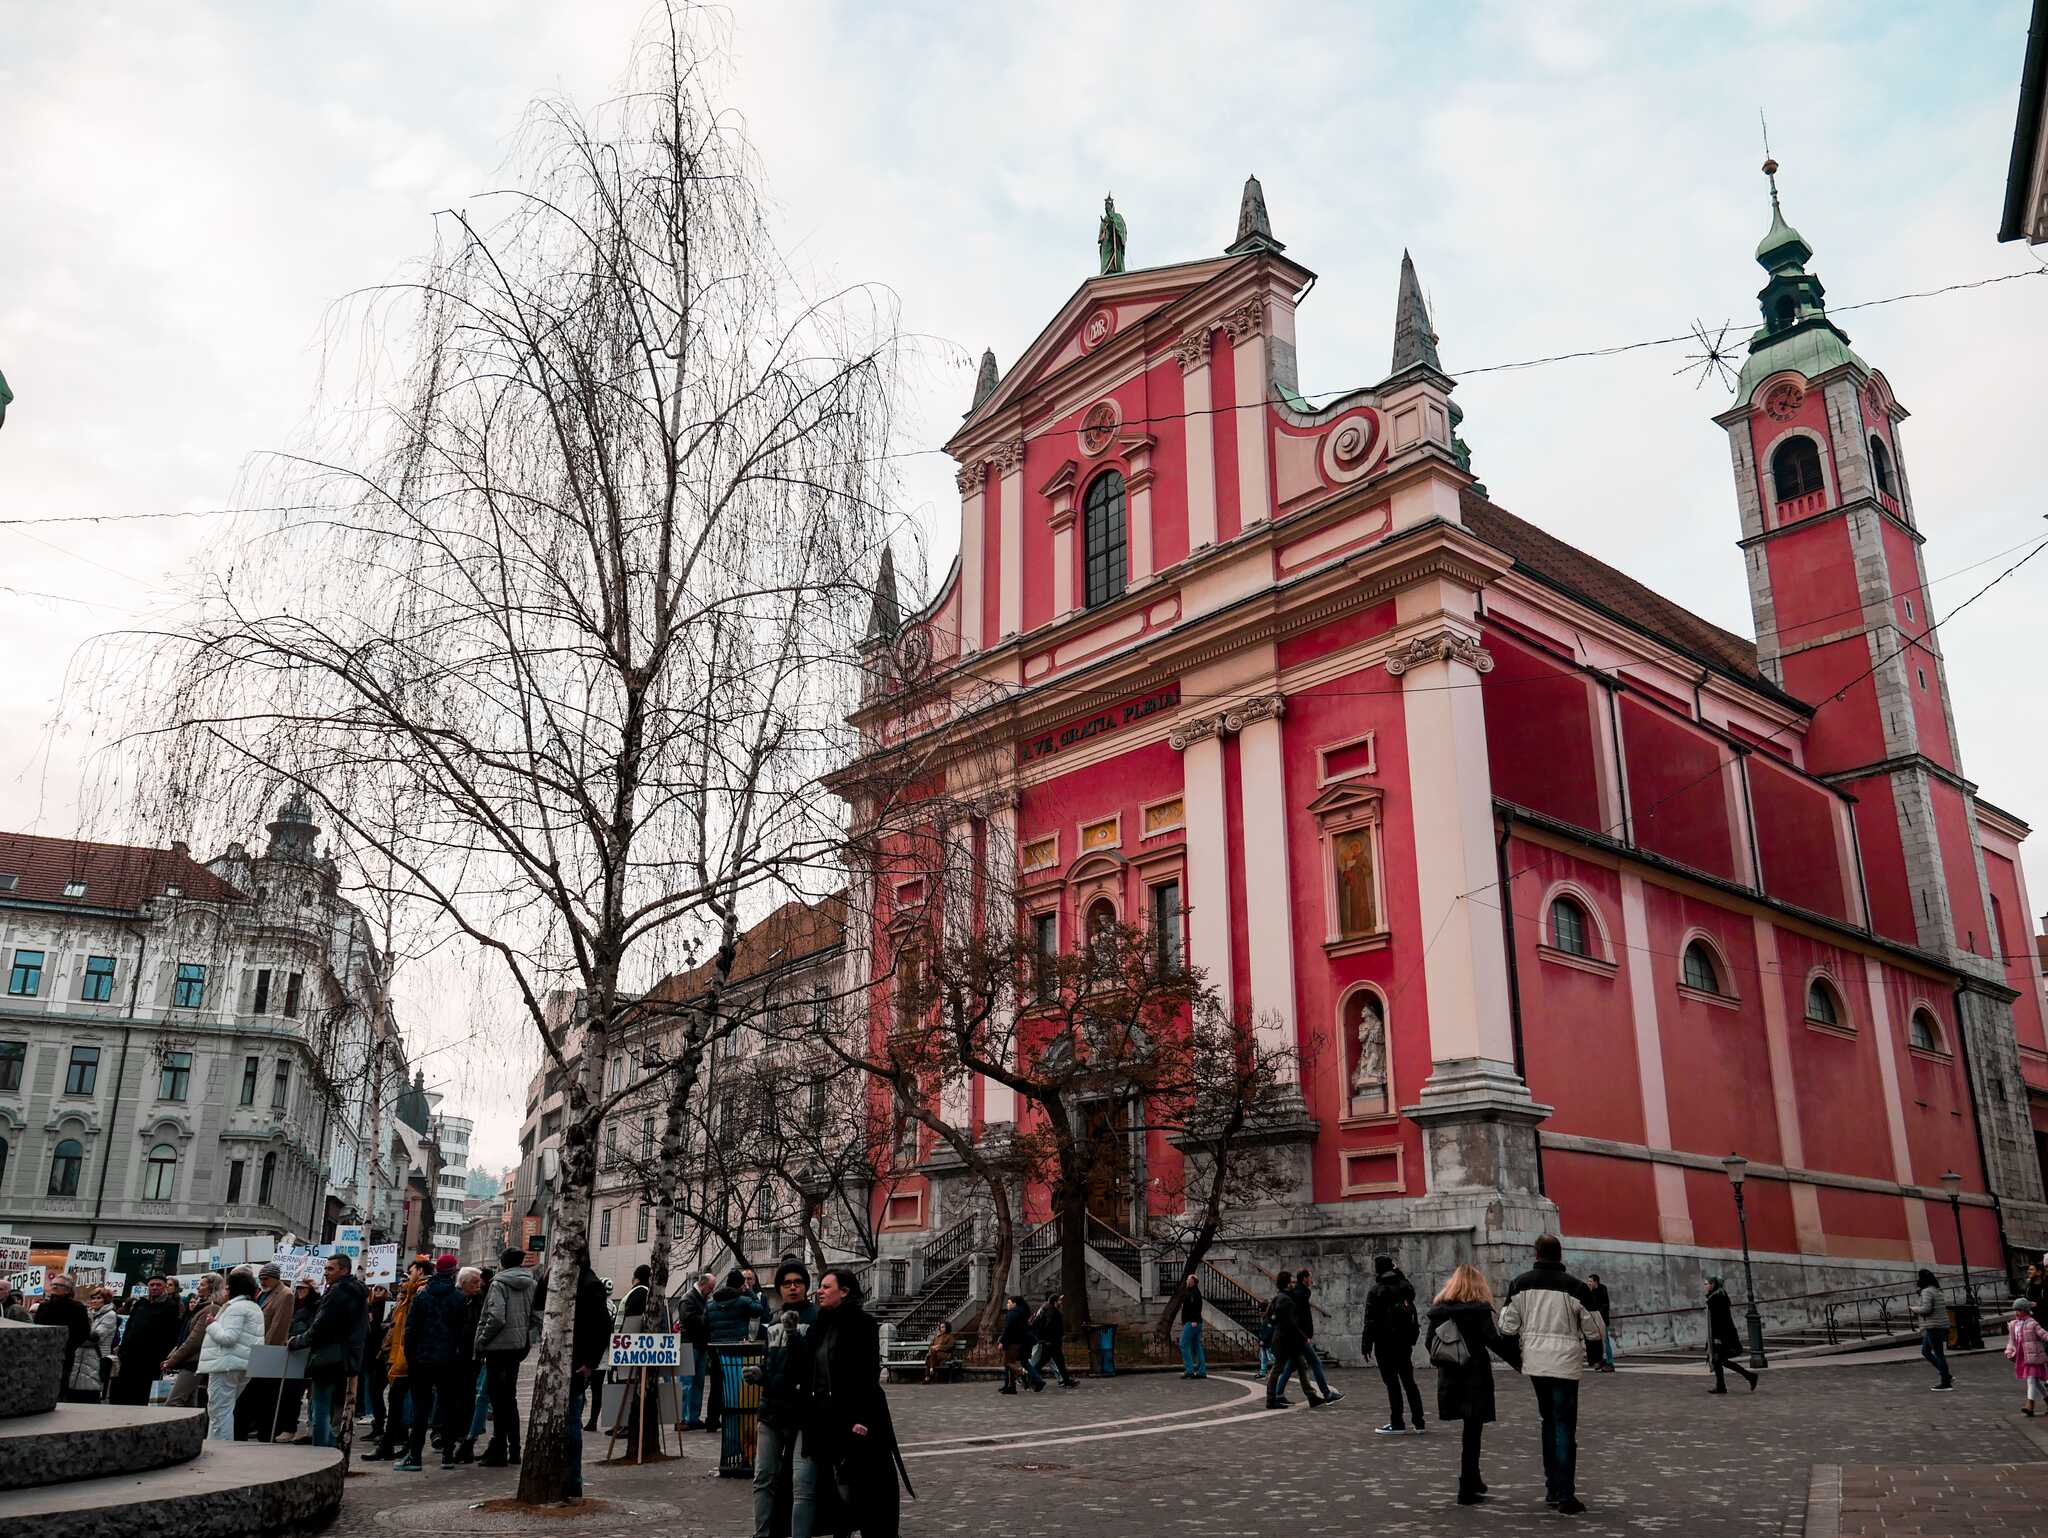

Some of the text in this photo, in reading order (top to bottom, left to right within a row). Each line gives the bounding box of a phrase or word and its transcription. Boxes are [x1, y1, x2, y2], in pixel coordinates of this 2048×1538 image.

[1060, 716, 1118, 746] GRATIA
[304, 1245, 320, 1257] 5G
[30, 1270, 41, 1287] 5G
[612, 1335, 632, 1350] 5G
[638, 1335, 654, 1349] TO
[660, 1335, 674, 1349] JE
[613, 1350, 677, 1365] SAMOMOR!
